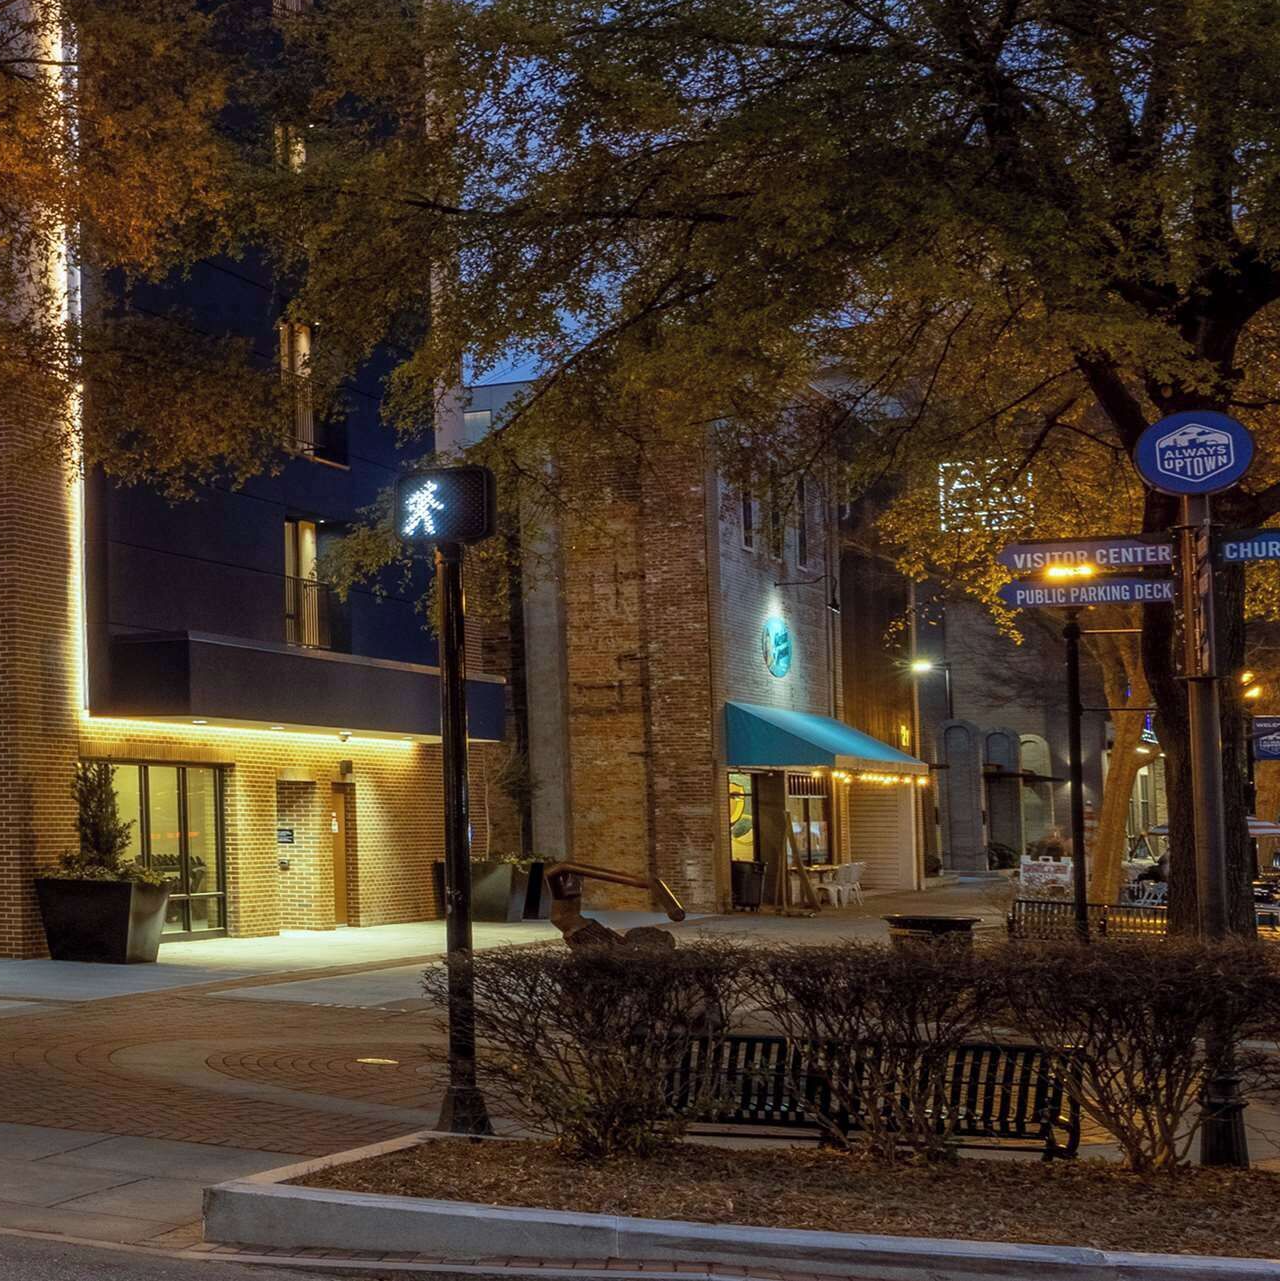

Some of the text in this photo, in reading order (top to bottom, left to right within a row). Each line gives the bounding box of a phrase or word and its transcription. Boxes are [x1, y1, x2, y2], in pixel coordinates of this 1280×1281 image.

[1164, 445, 1227, 460] ALWAYS
[1164, 454, 1228, 476] UPTOWN
[1013, 544, 1171, 569] VISITOR CENTER
[1016, 582, 1173, 606] PUBLIC PARKING DECK
